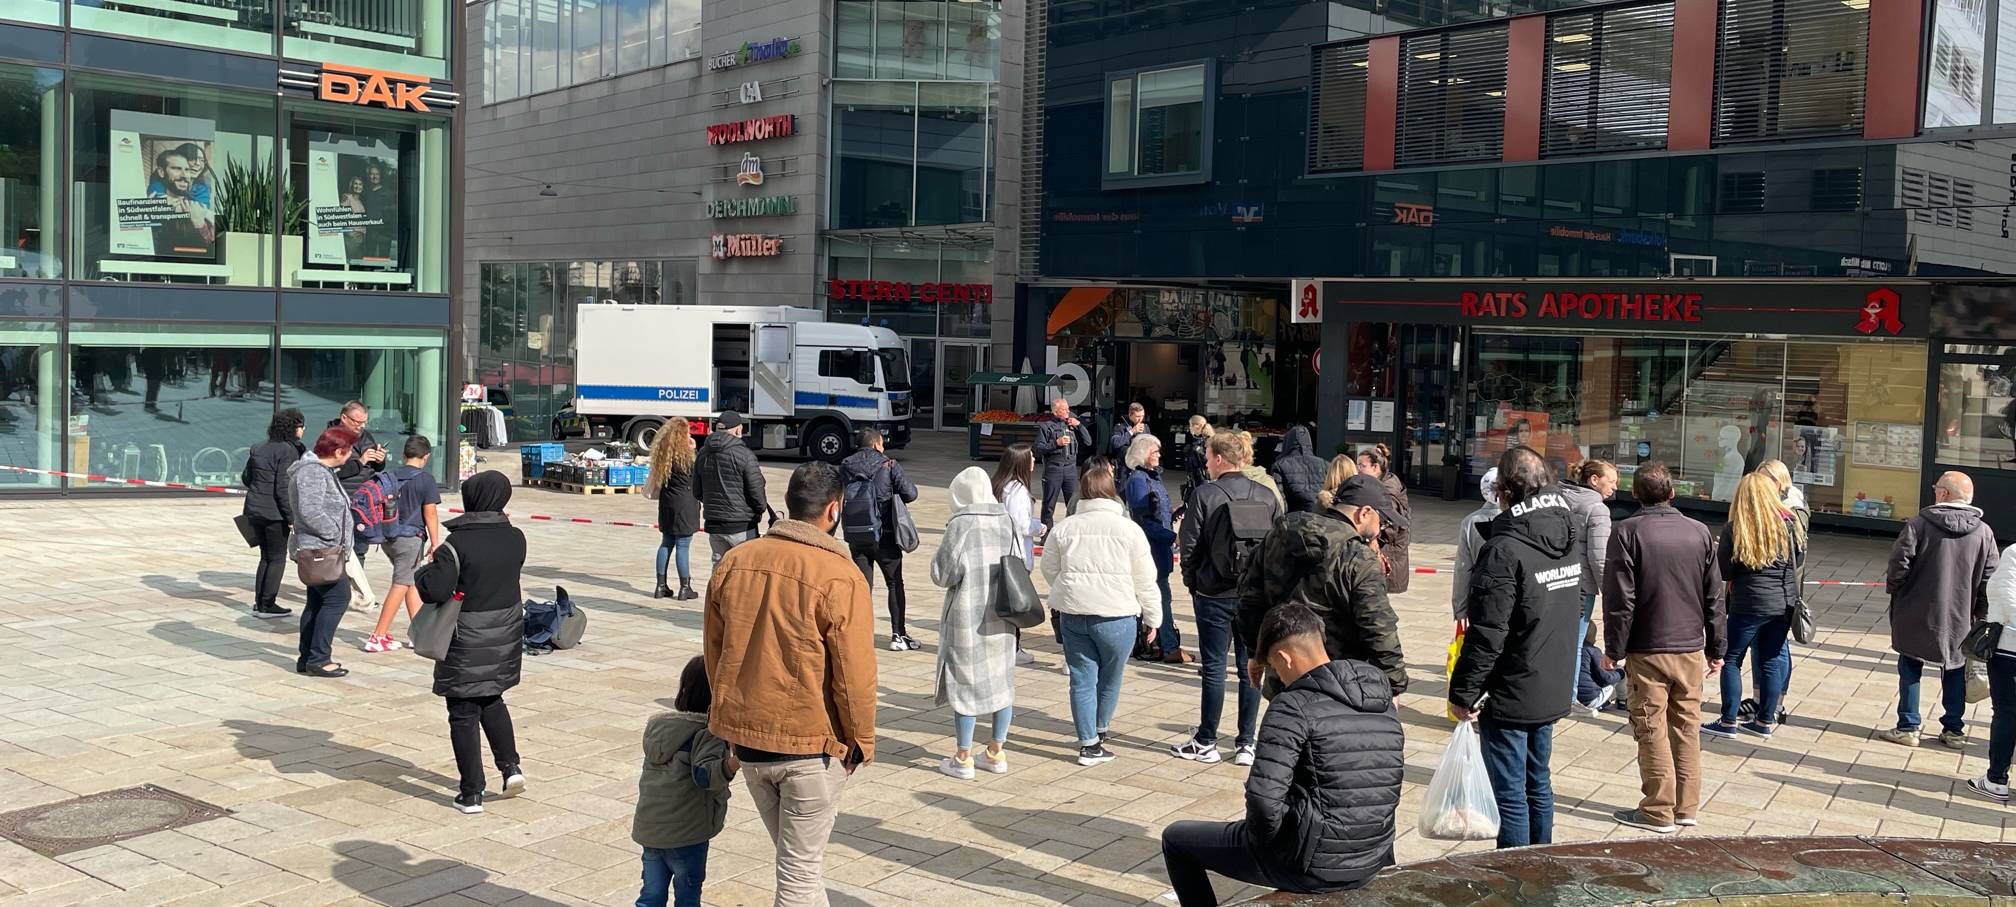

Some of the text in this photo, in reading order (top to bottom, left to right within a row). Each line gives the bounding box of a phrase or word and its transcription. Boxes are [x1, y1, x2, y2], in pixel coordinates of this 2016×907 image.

[321, 63, 432, 112] DAK
[706, 114, 793, 146] WOOLWORTH
[741, 152, 760, 173] dm
[706, 196, 793, 218] DEICHMANN
[727, 234, 782, 257] Müller
[831, 280, 911, 301] STERN
[1461, 292, 1528, 318] RATS
[1538, 293, 1703, 321] APOTHEKE
[658, 389, 699, 400] POLIZEI
